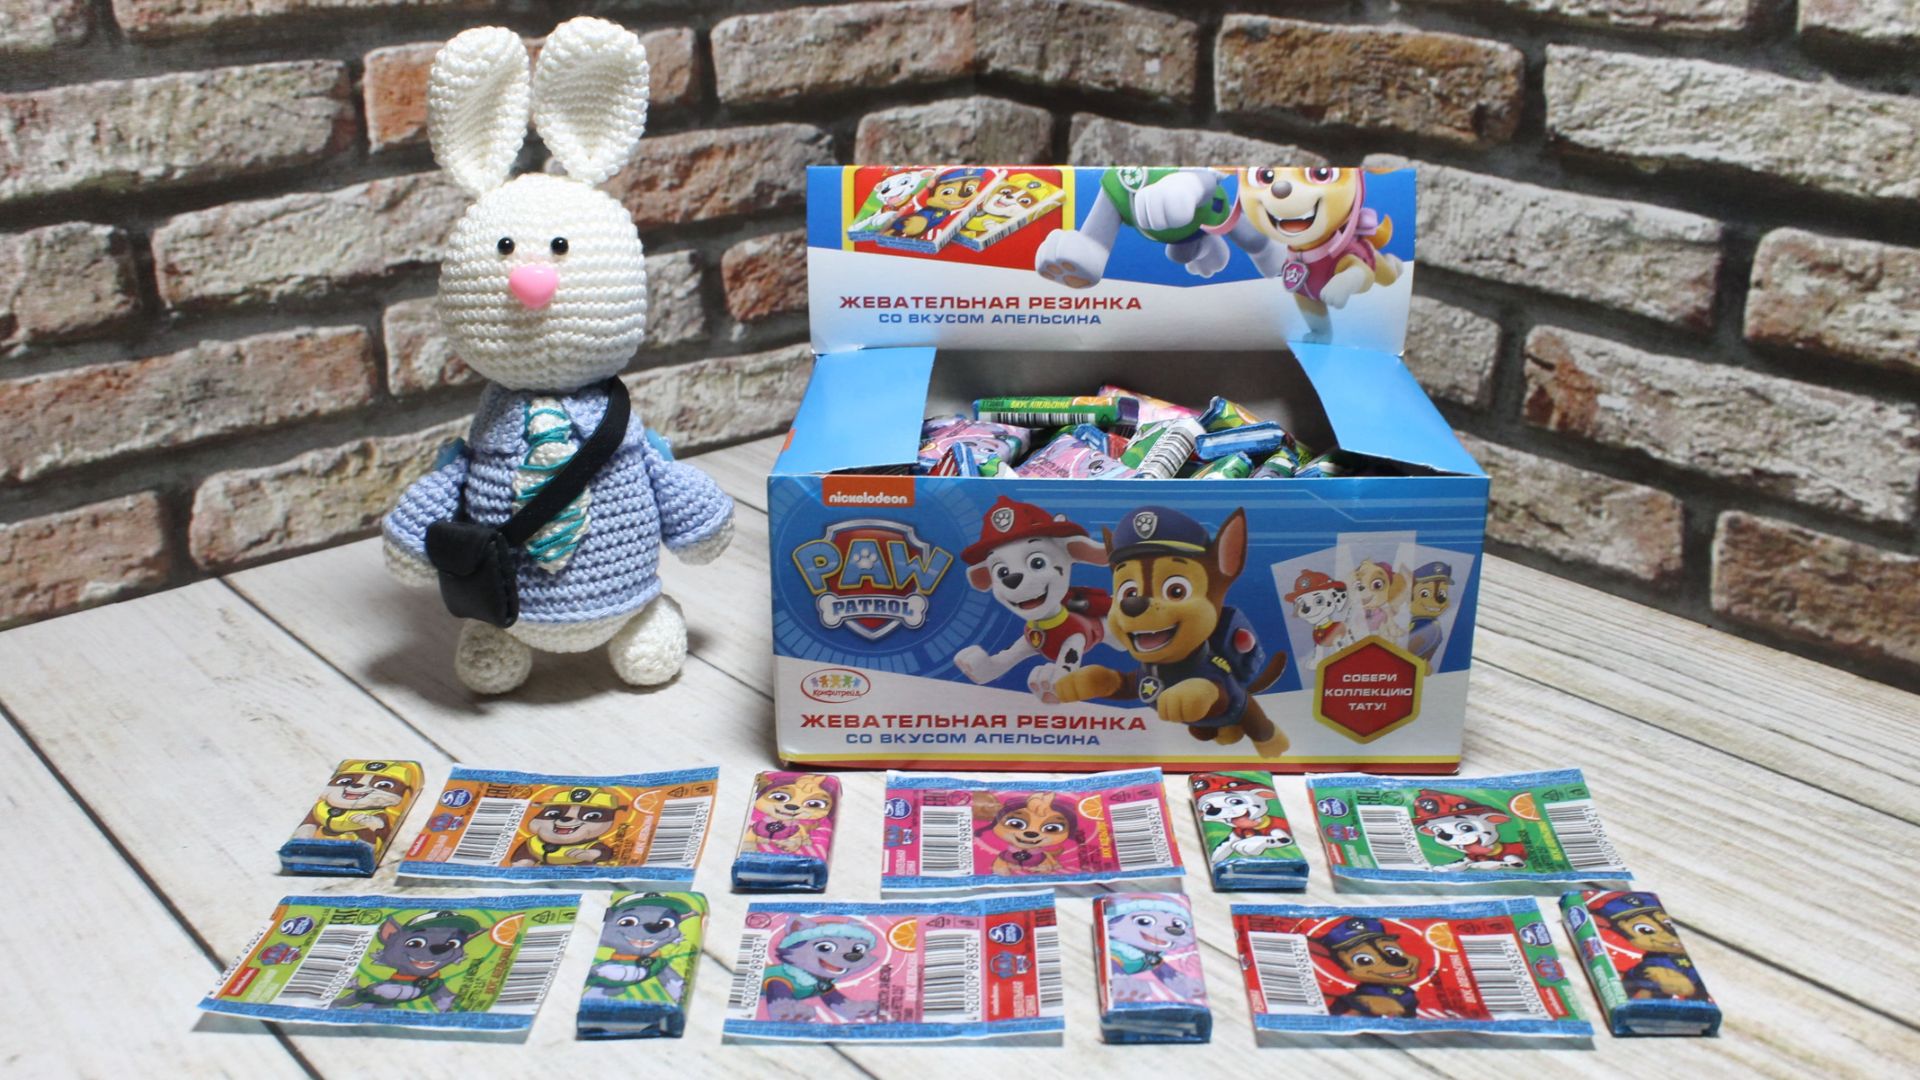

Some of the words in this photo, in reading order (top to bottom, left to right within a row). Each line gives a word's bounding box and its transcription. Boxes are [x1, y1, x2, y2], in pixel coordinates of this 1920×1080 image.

[839, 296, 1020, 310] ЖЕВАТЕЛЬНАЯ
[1029, 297, 1142, 310] РЕЗИНКА
[878, 313, 903, 324] СО
[908, 313, 985, 325] ВКУСОМ
[991, 314, 1102, 325] АПЕЛЬСИНА
[828, 491, 908, 504] nickelodeon
[792, 538, 954, 596] PAW
[831, 599, 914, 616] PATROL
[1342, 673, 1398, 683] СОБЕРИ
[1324, 687, 1413, 698] КОЛЛЕКЦИЮ
[1348, 702, 1387, 712] ТАТУ!
[800, 714, 1007, 730] ЖЕВАТЕЛЬНАЯ
[1017, 715, 1147, 731] РЕЗИНКА
[846, 733, 873, 745] СО
[880, 733, 966, 745] ВКУСОМ
[974, 733, 1101, 746] АПЕЛЬСИНА
